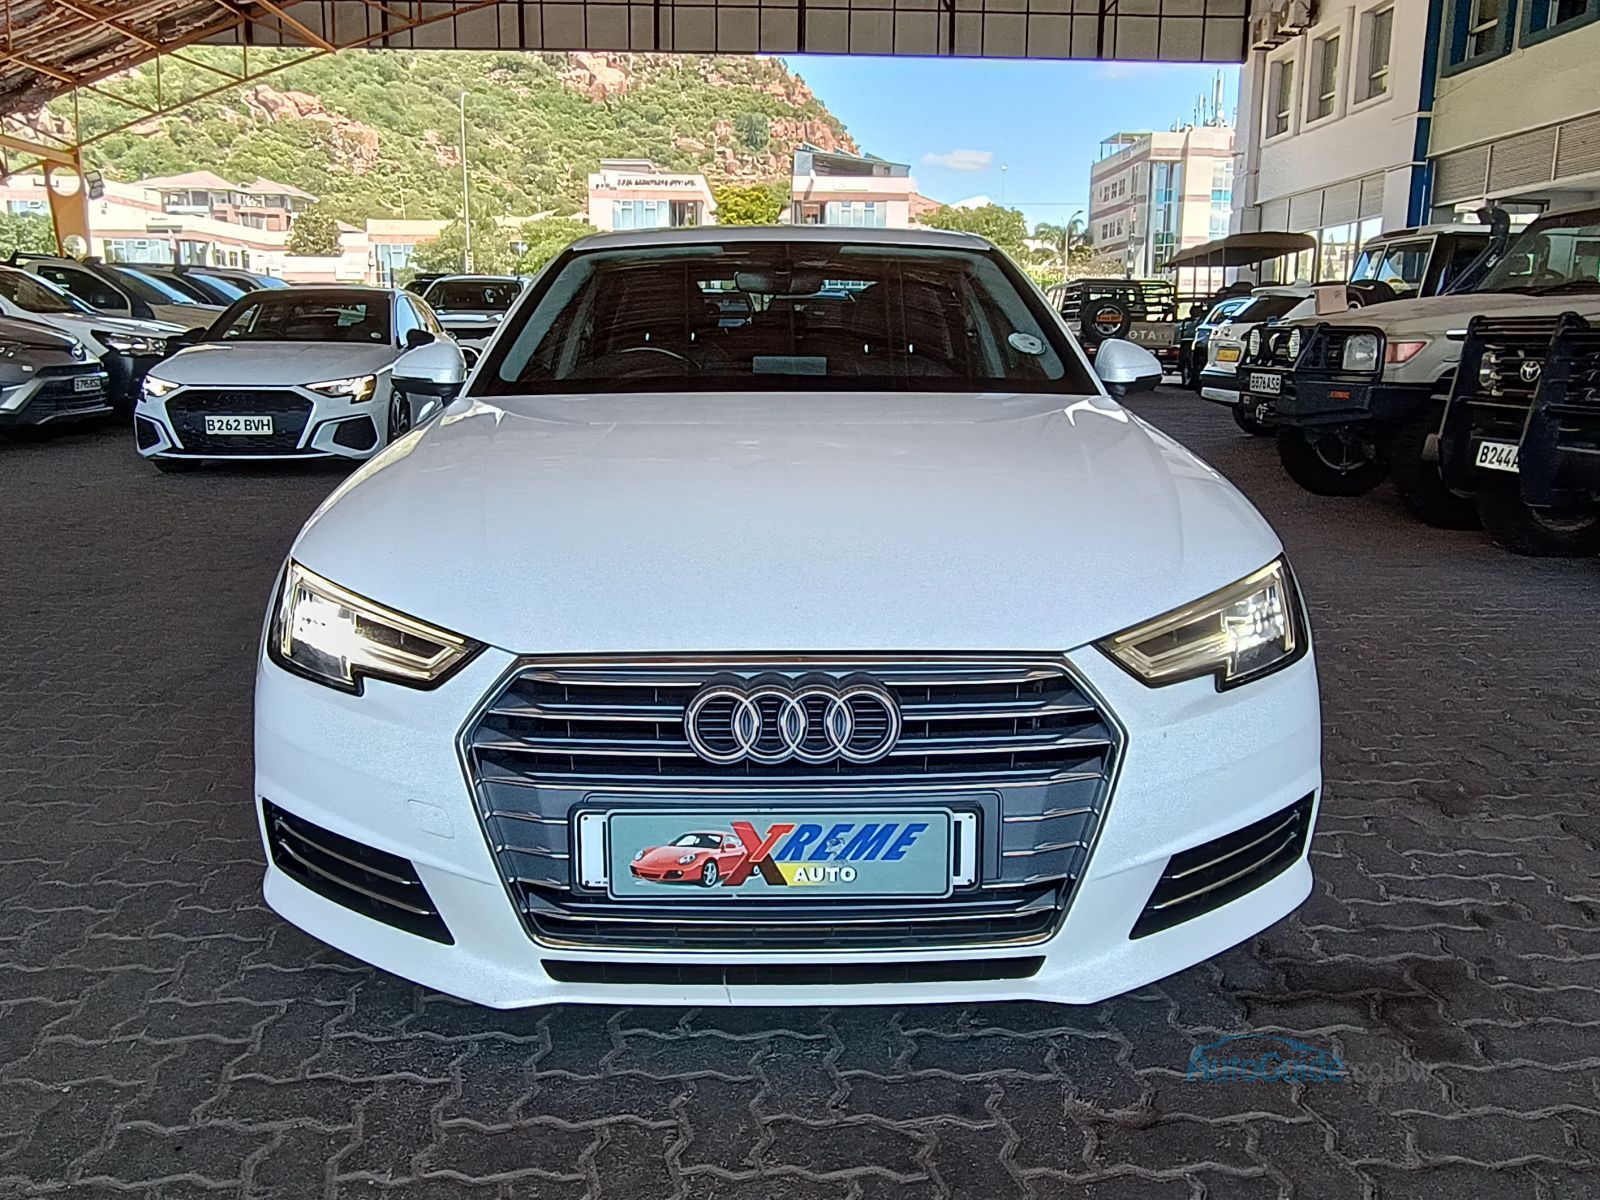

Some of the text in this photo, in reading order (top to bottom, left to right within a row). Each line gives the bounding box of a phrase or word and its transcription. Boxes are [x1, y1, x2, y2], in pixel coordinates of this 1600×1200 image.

[206, 418, 271, 431] B262 BVH
[792, 866, 858, 883] AUTO
